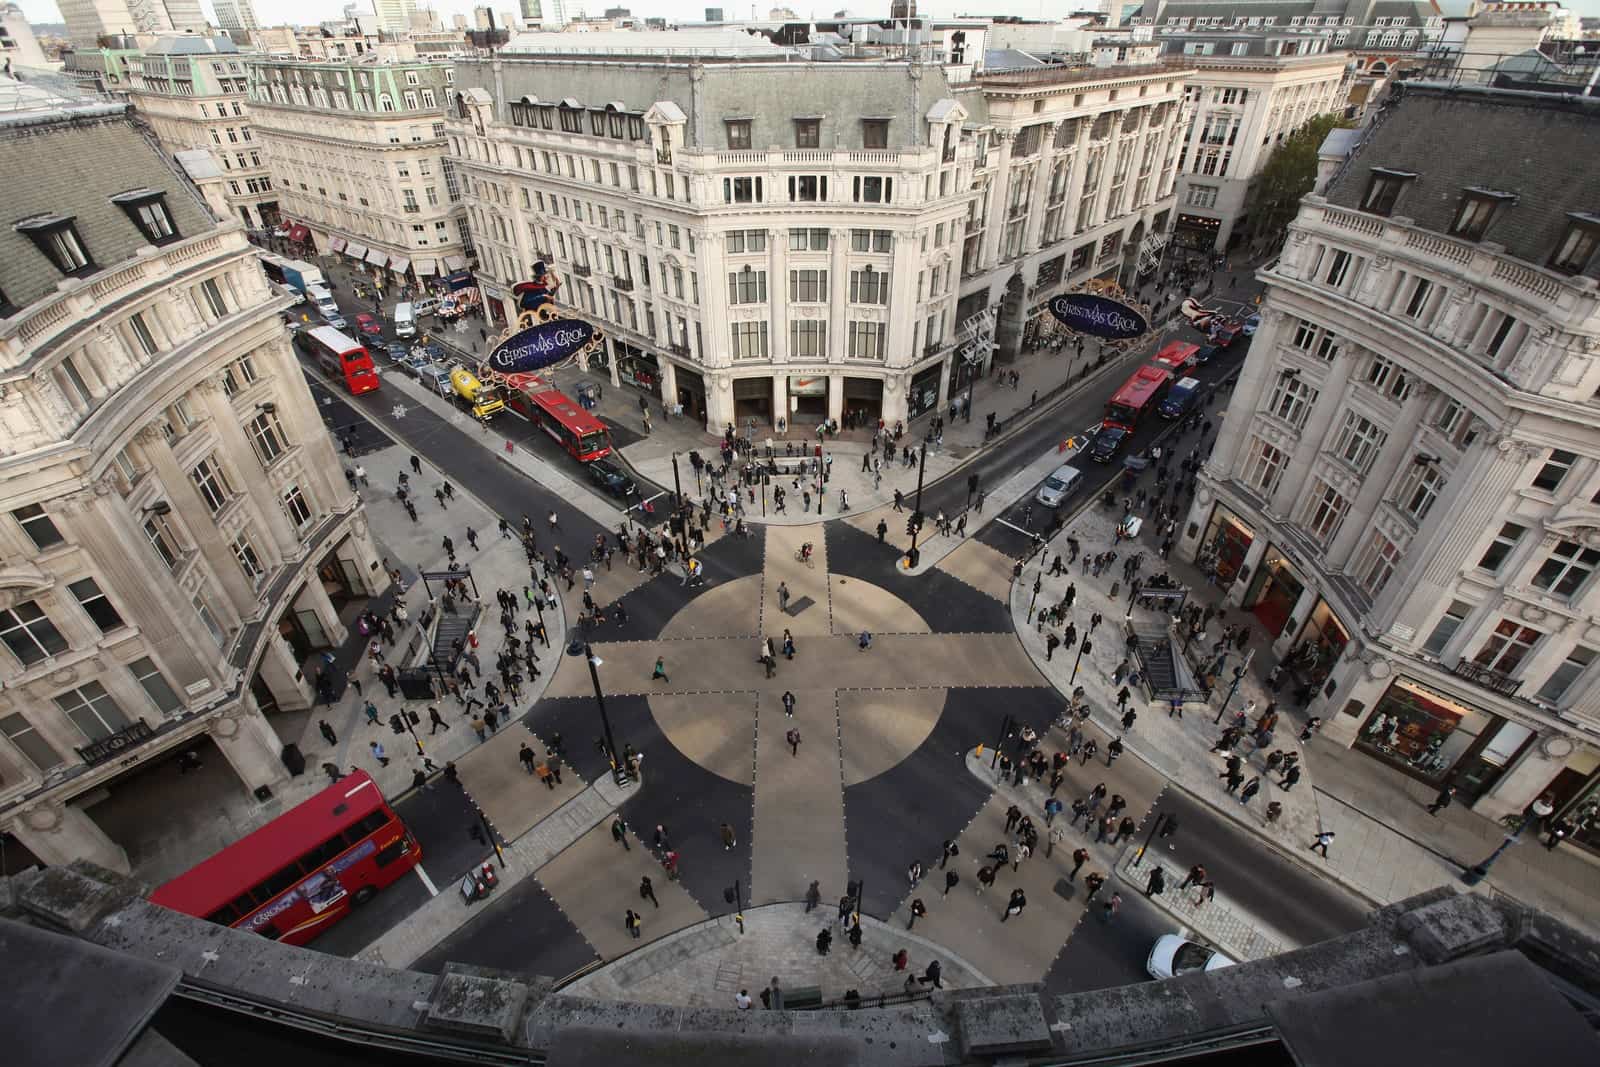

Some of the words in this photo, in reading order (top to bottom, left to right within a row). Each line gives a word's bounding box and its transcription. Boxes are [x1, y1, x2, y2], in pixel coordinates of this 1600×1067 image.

[1055, 298, 1106, 325] CHRISTMAS
[1107, 311, 1138, 331] CAROL
[496, 333, 554, 366] CHRISTMAS
[554, 328, 586, 347] CAROL
